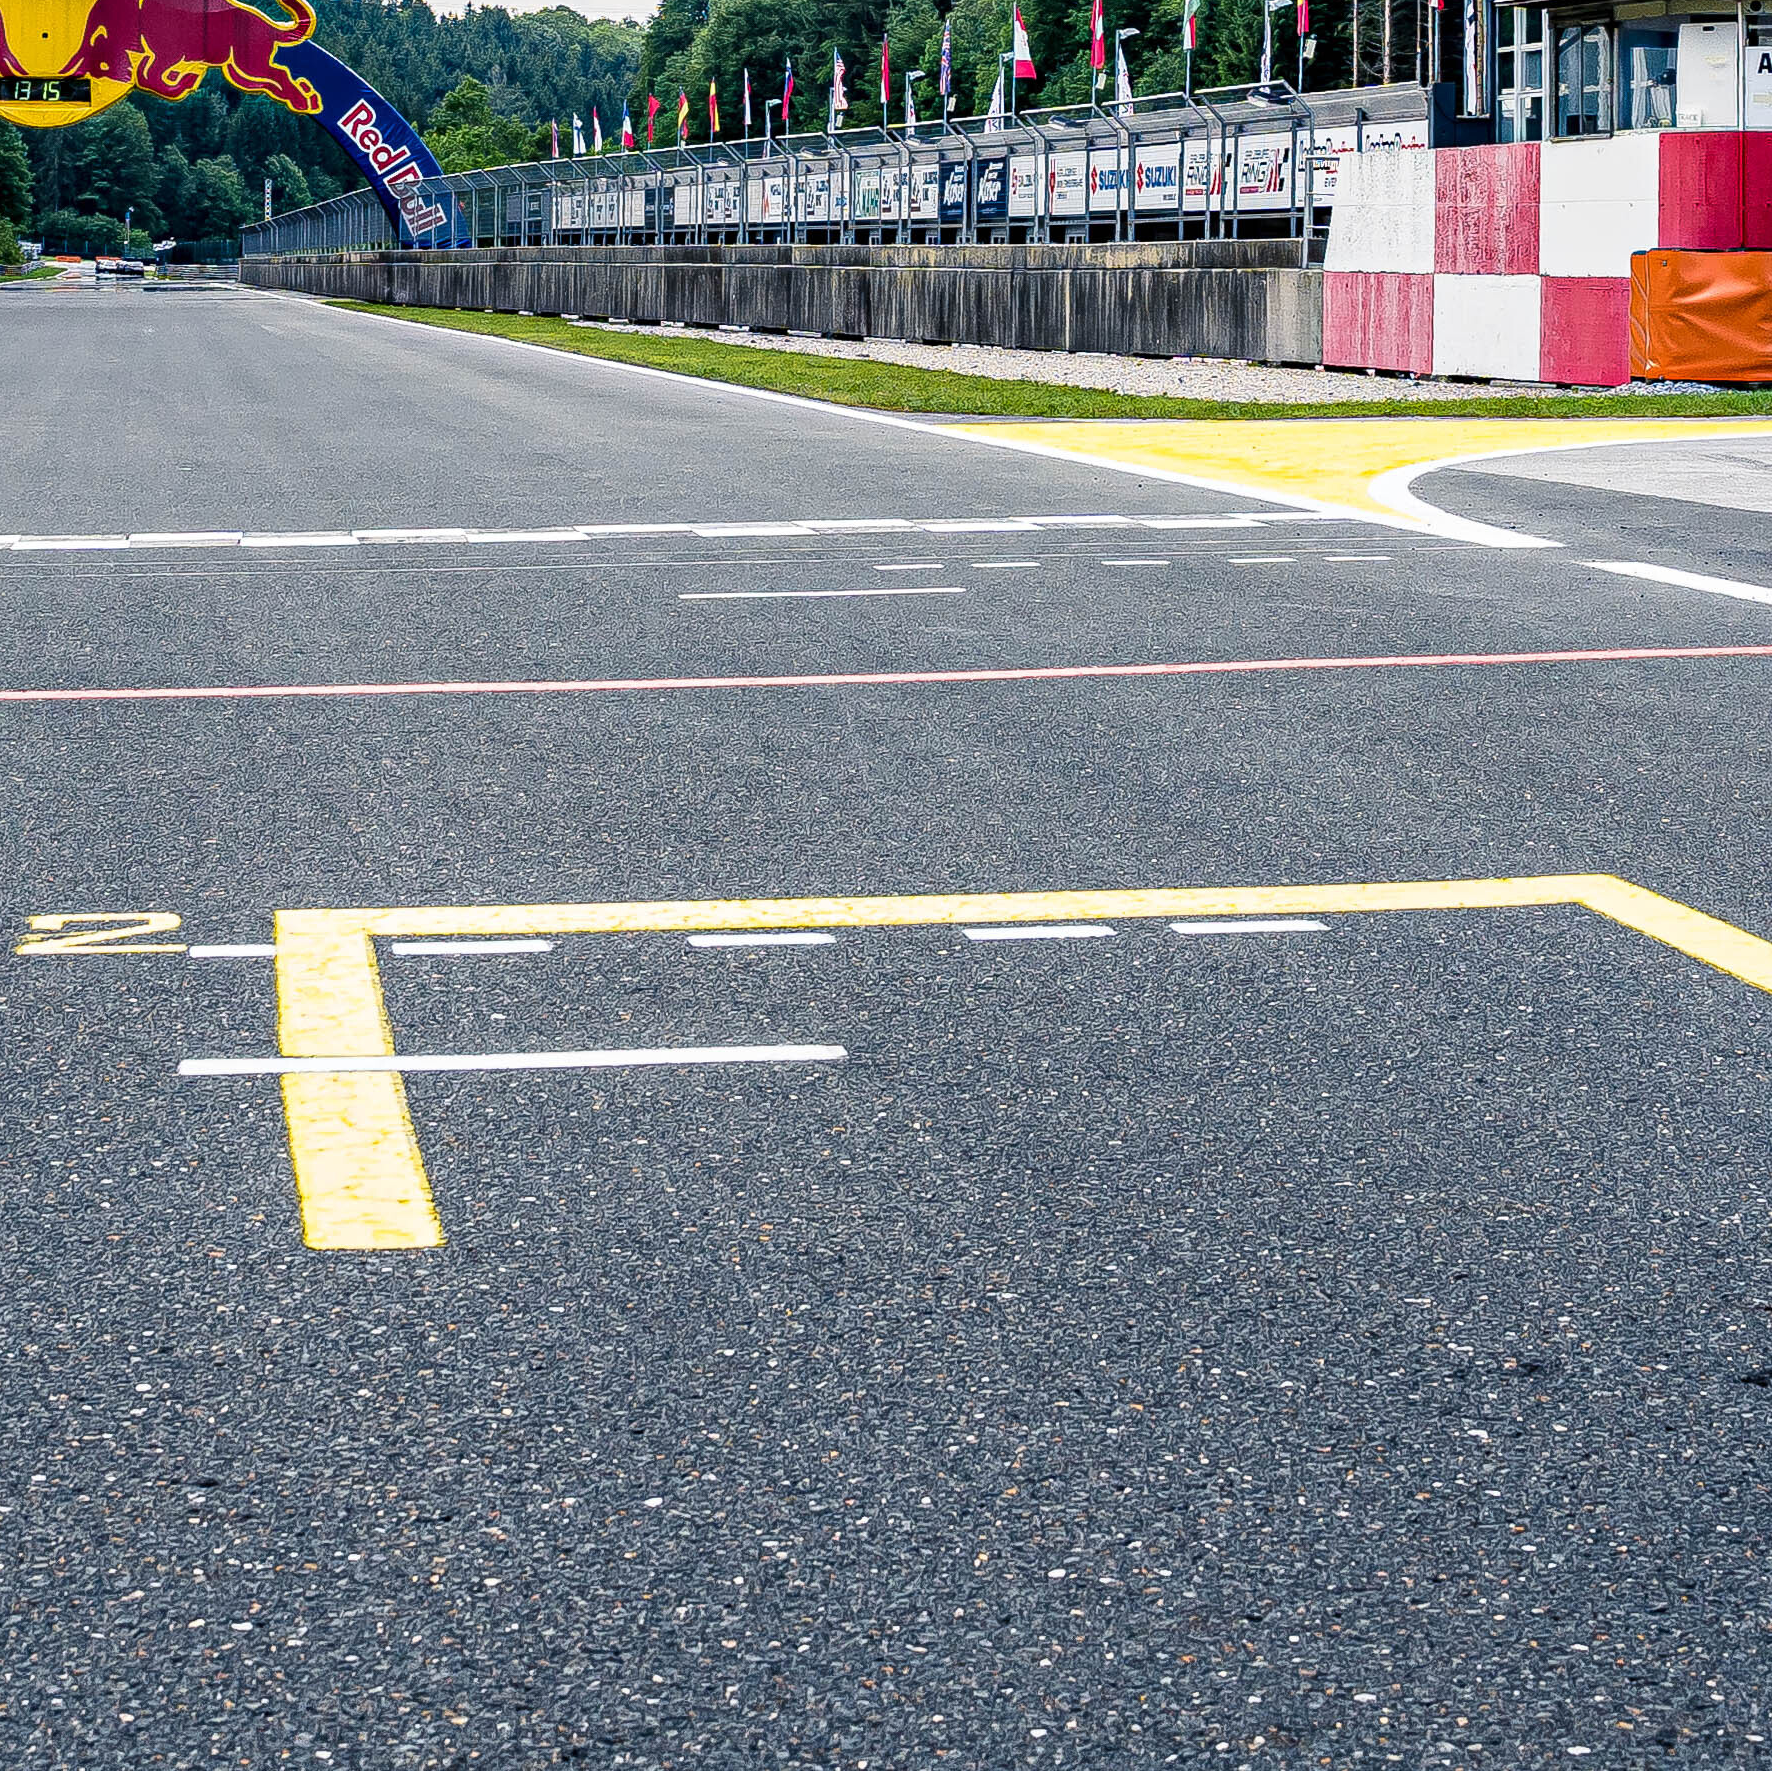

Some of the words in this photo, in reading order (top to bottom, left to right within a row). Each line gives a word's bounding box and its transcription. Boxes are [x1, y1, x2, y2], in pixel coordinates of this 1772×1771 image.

[337, 98, 411, 175] Red
[382, 161, 448, 237] Bull
[1145, 165, 1177, 188] SUZUKI
[14, 912, 188, 955] 2
